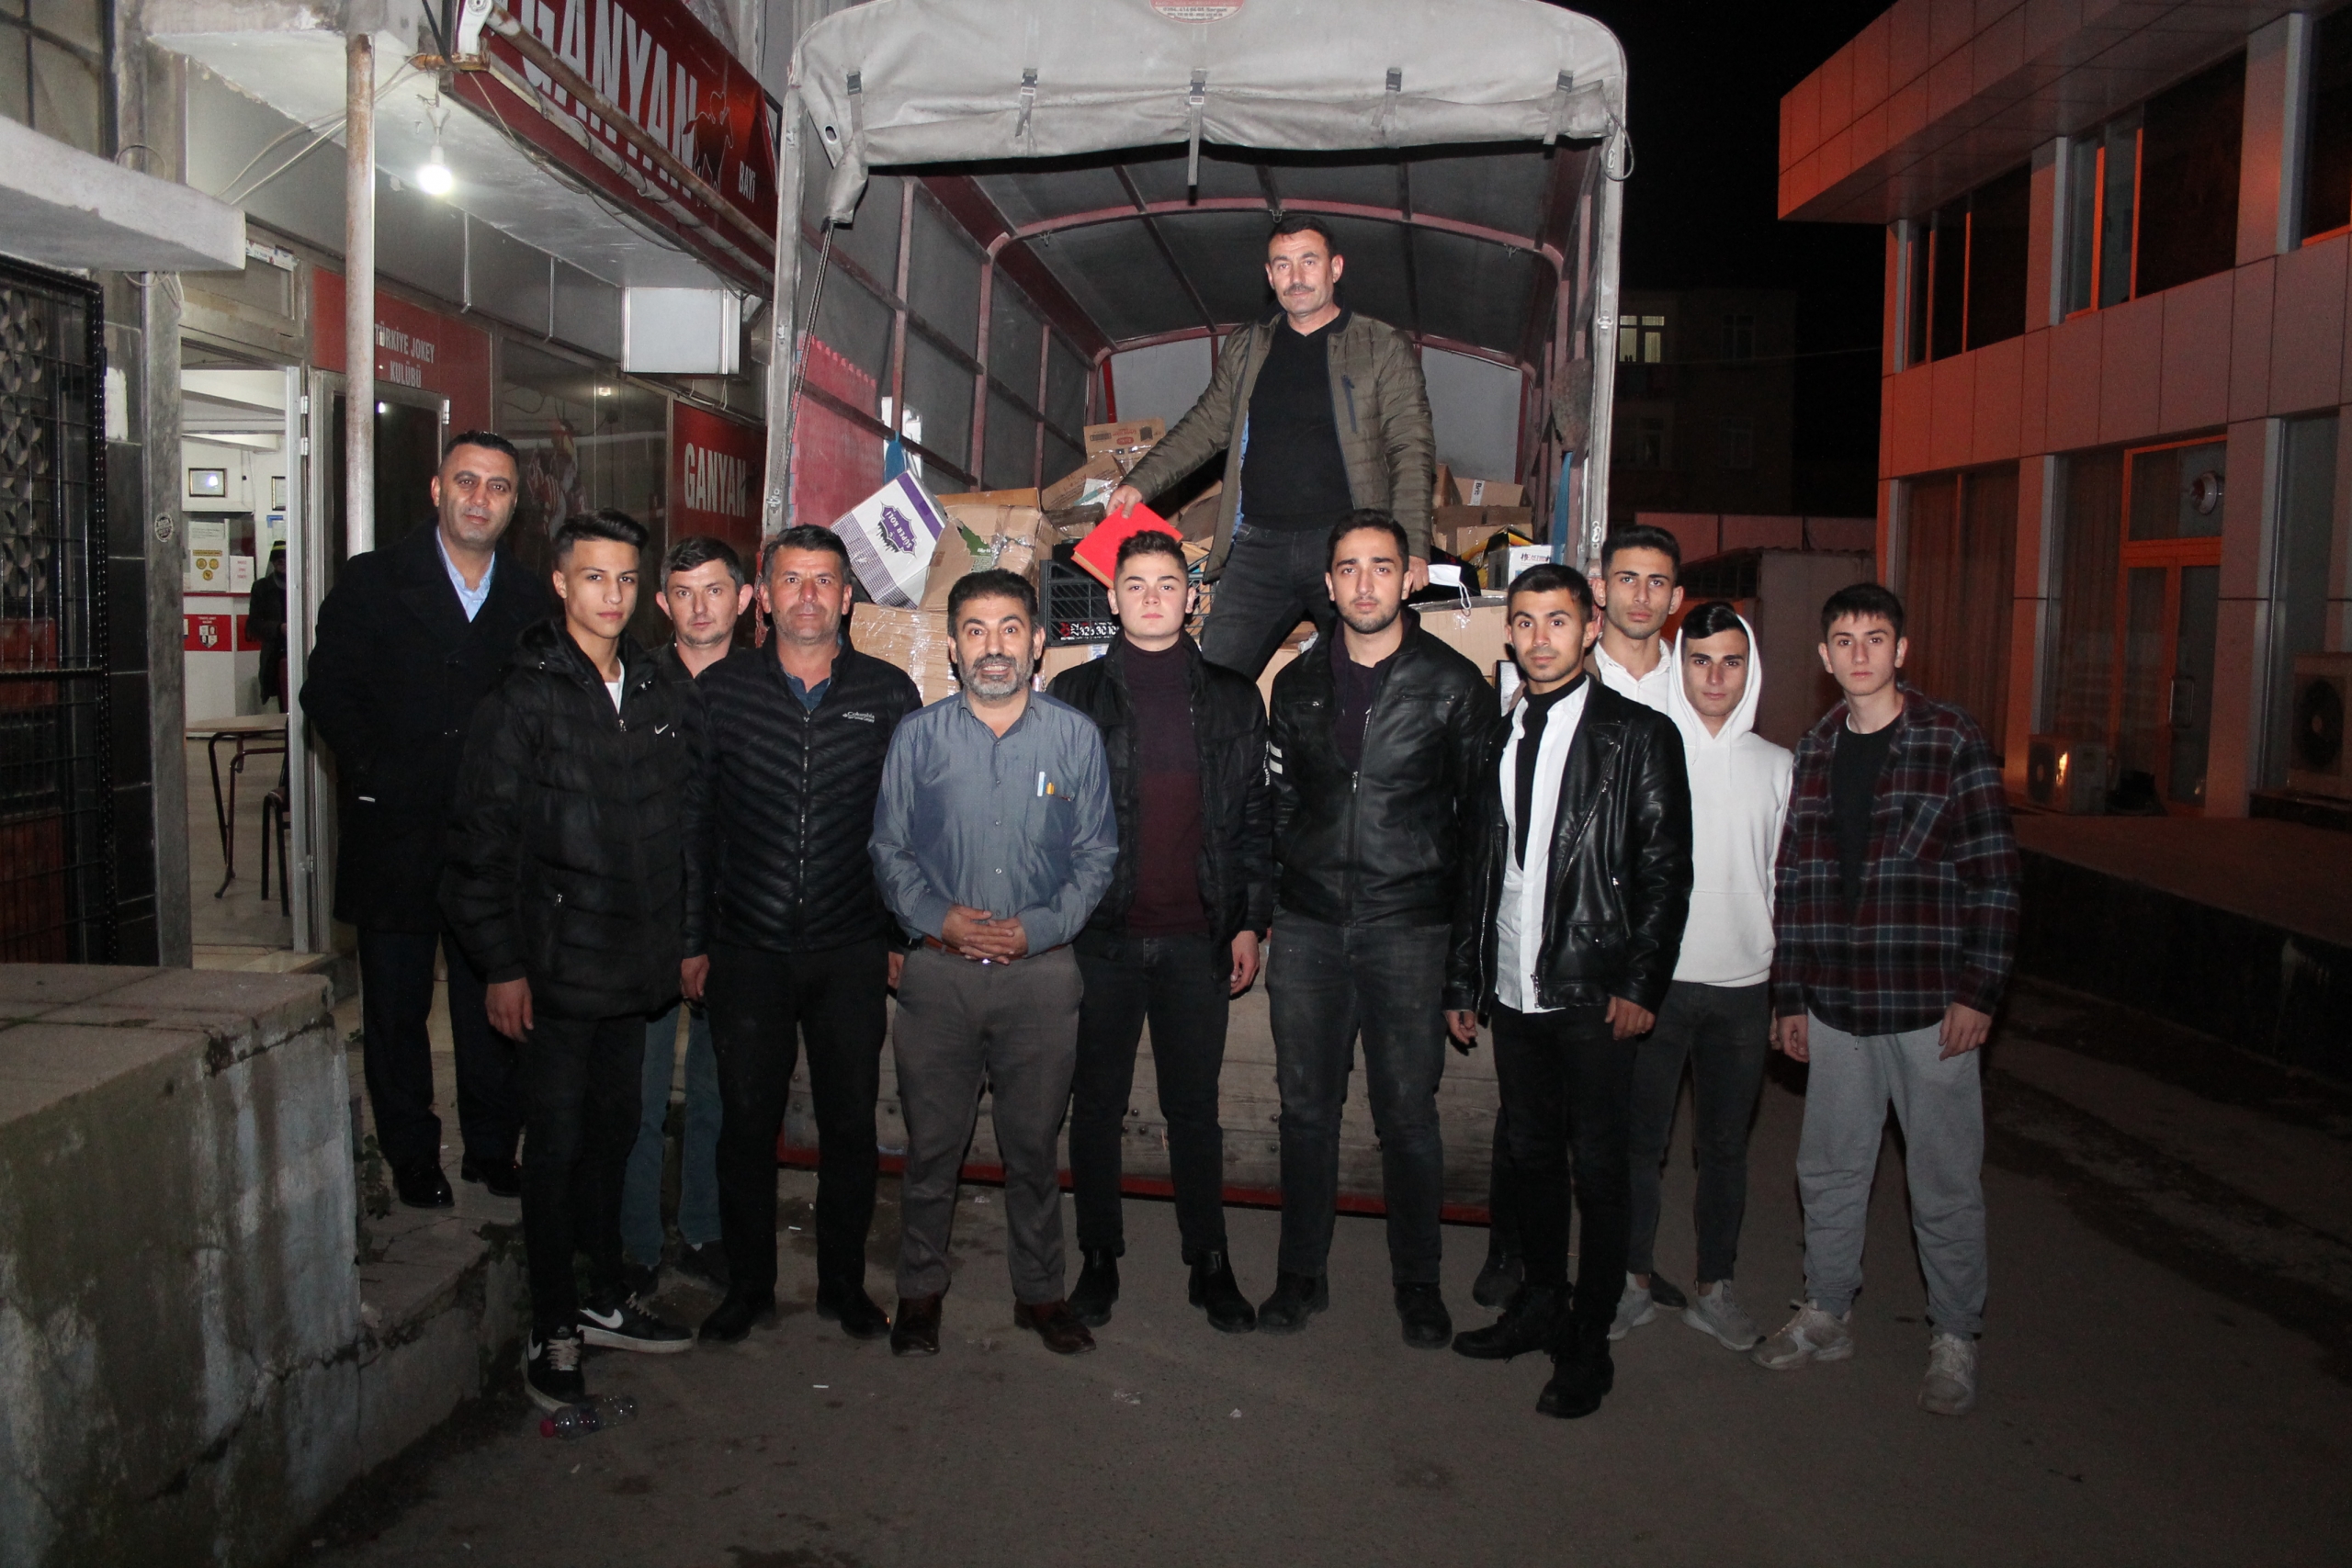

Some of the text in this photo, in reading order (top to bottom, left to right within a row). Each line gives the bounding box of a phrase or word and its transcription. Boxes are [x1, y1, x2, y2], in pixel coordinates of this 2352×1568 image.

[738, 160, 756, 203] BAYİ
[375, 321, 435, 364] TÜRKİYE JOKEY
[390, 360, 422, 389] KULÜBÜ
[684, 442, 747, 518] GANYAN
[896, 526, 912, 548] SÜPER
